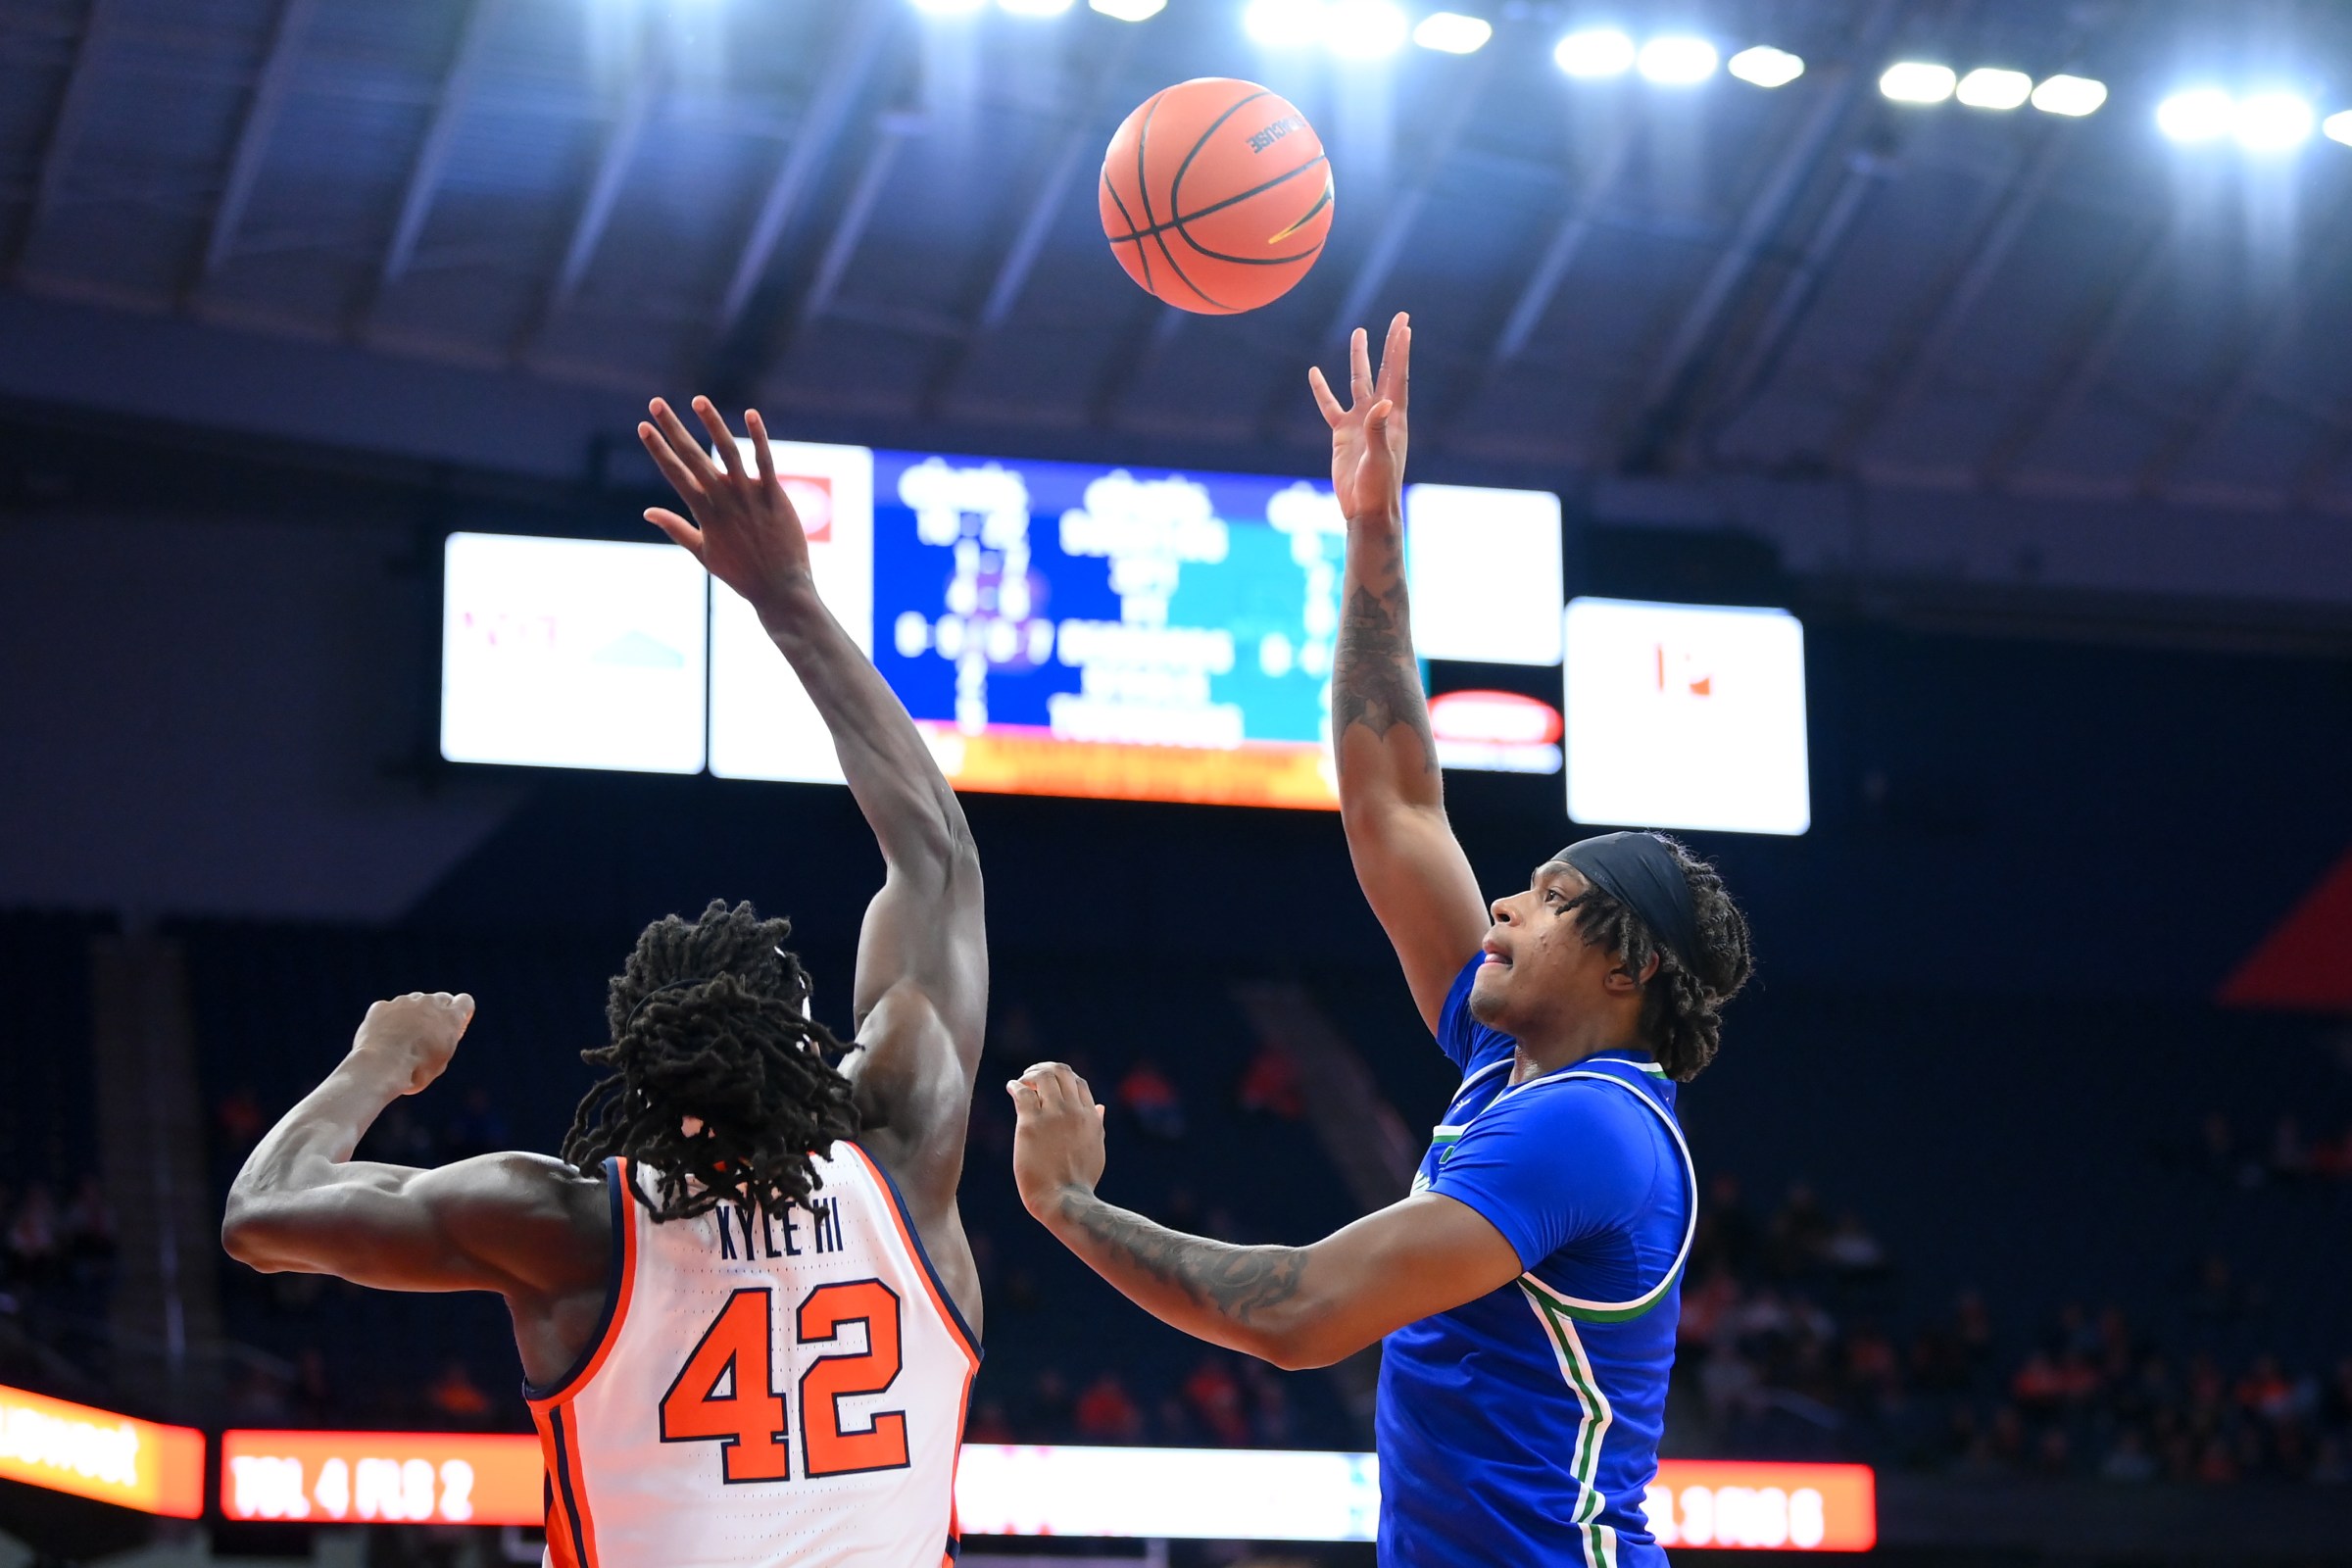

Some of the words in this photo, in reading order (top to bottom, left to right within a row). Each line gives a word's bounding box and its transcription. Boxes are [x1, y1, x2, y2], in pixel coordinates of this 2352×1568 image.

[715, 1200, 801, 1261] KYLE
[659, 1278, 910, 1485] 42
[314, 1457, 349, 1519] 4
[440, 1459, 474, 1521] 2
